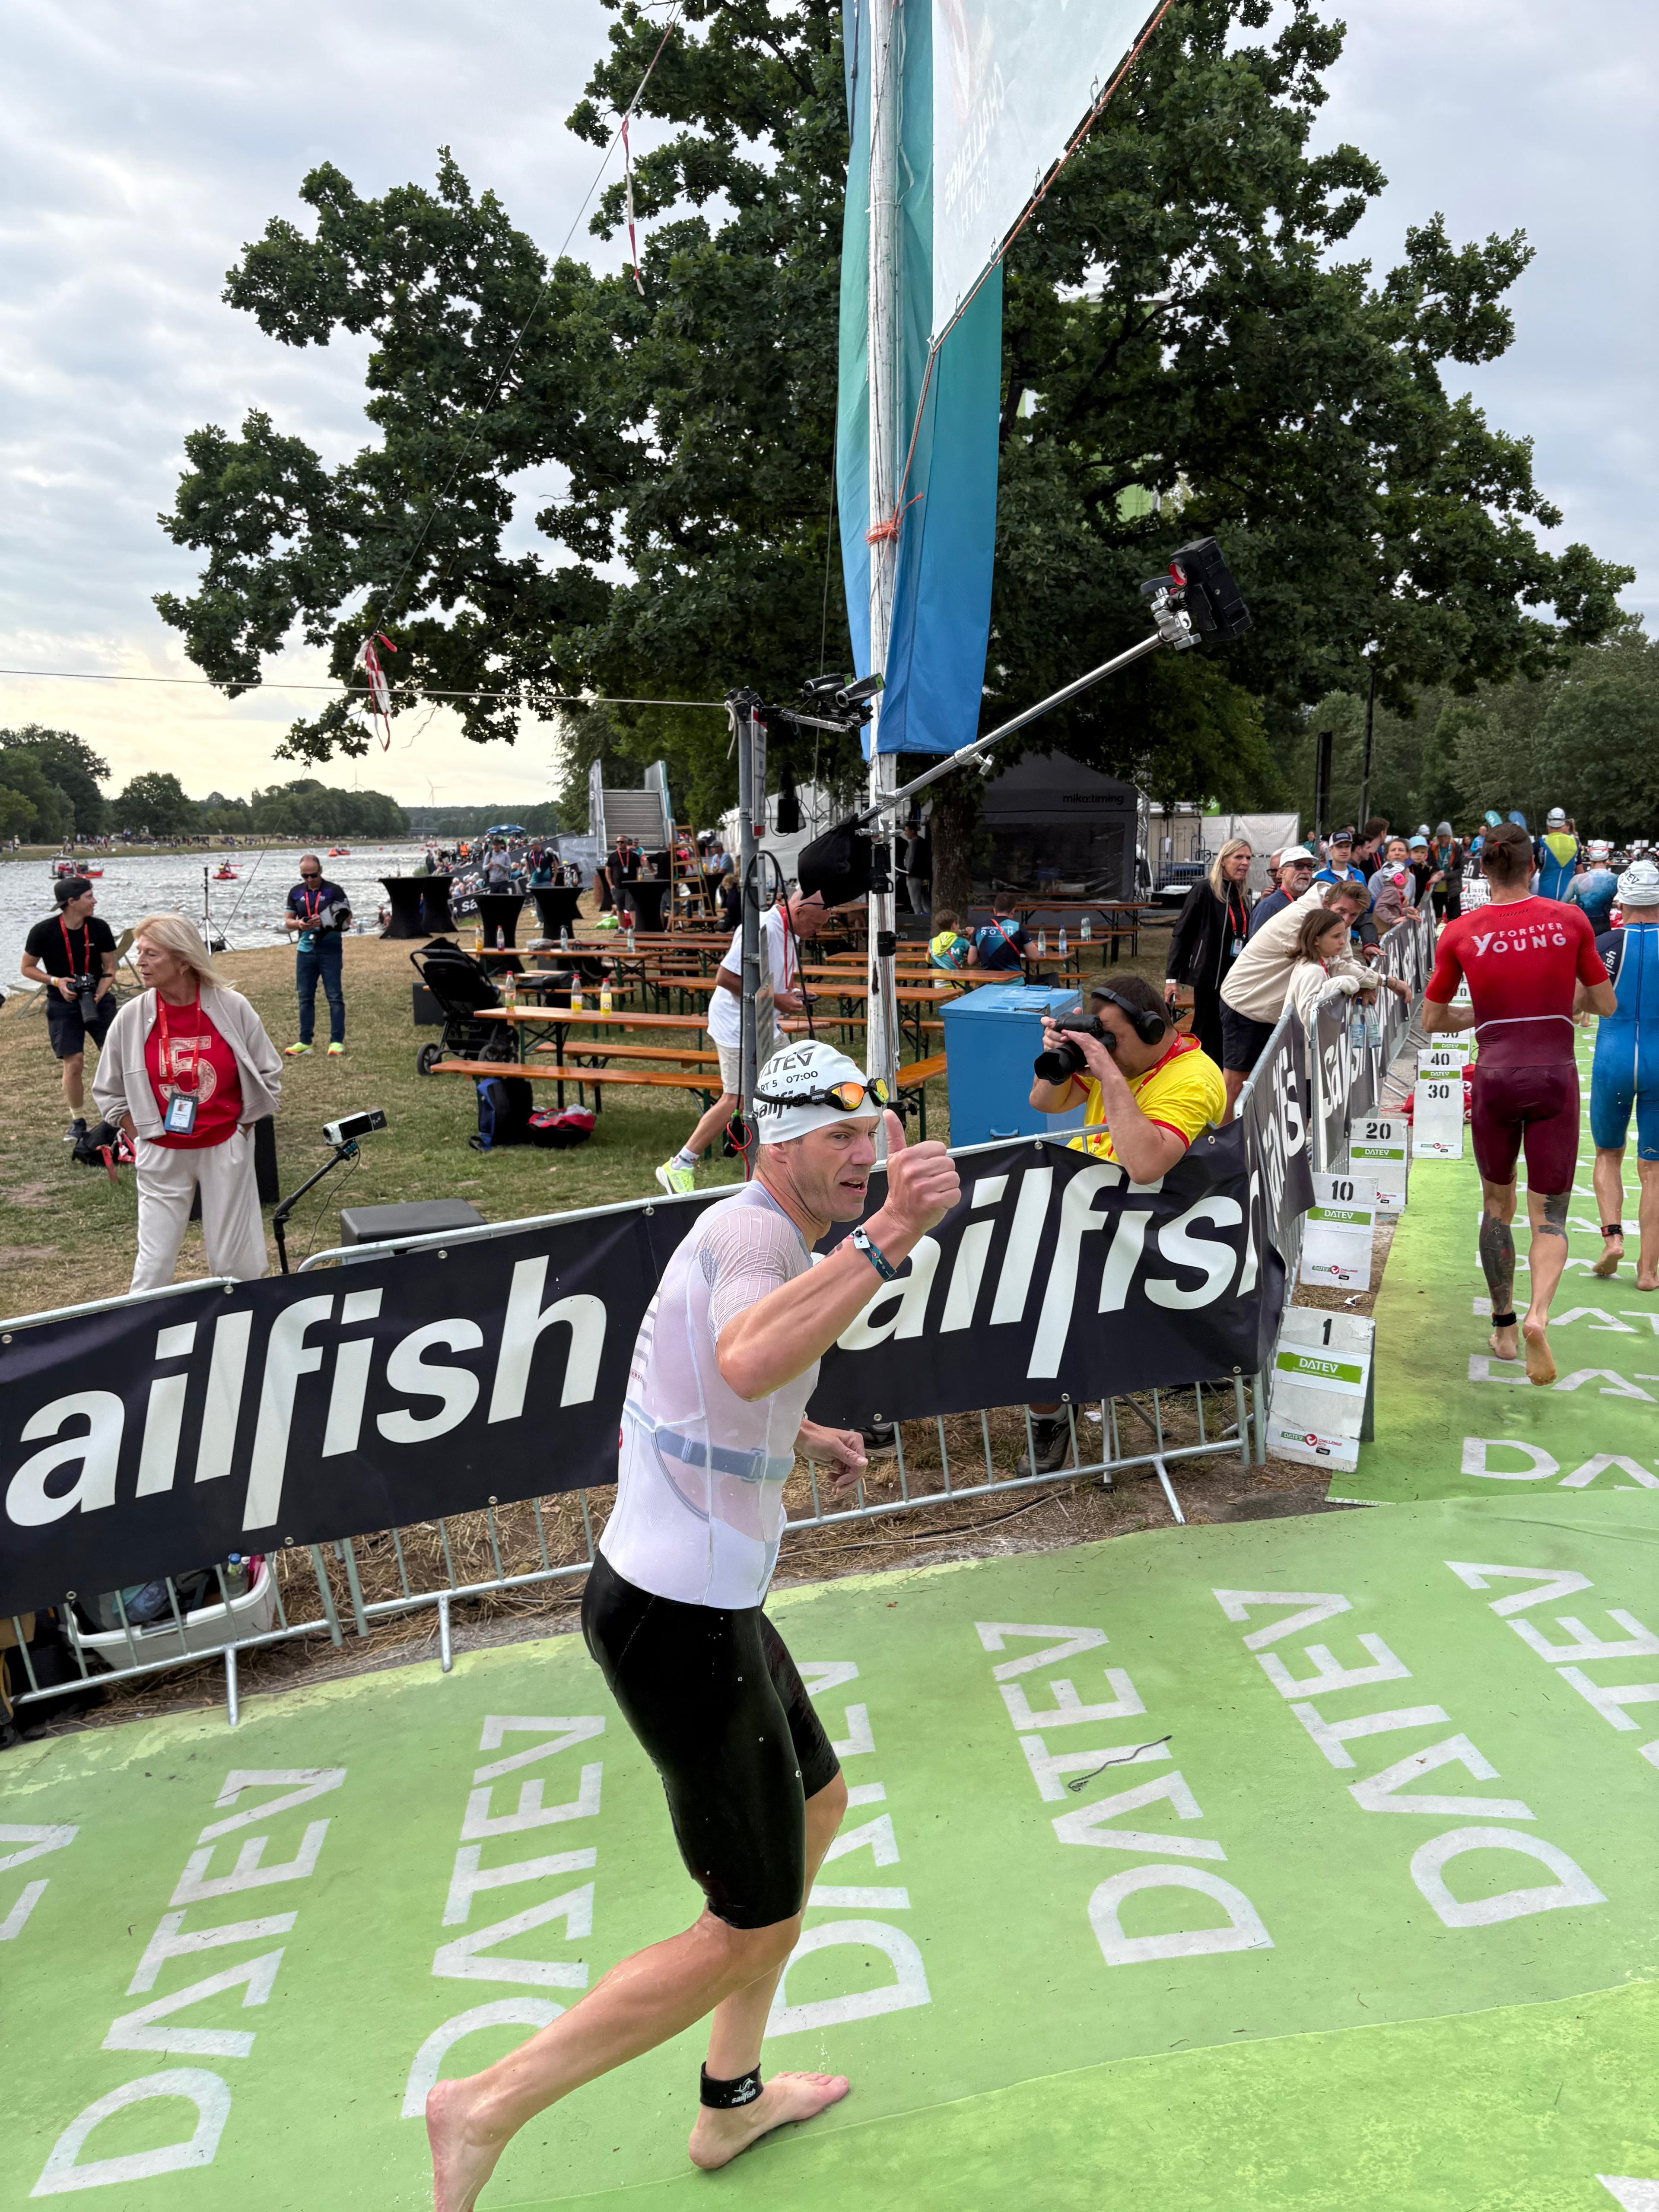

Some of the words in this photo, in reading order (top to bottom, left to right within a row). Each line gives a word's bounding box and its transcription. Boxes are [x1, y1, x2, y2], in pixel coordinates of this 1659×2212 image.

[1499, 923, 1563, 938] FOREVER
[1471, 931, 1566, 957] YOUNG
[1430, 1053, 1450, 1065] 40
[772, 1079, 778, 1087] 5
[786, 1071, 818, 1084] 07:00
[1428, 1084, 1449, 1099] 30
[1366, 1122, 1391, 1139] 20
[1332, 1180, 1354, 1201] 10
[1324, 1209, 1354, 1219] DATEV
[1322, 1318, 1332, 1345] 1
[1299, 1358, 1339, 1373] DATEV
[6, 1255, 607, 1532] ailfish
[1284, 1432, 1304, 1441] DATEV
[1211, 1588, 1608, 1927] DATEV
[974, 1621, 1275, 1966] DATEV
[29, 1767, 346, 2197] DATEV
